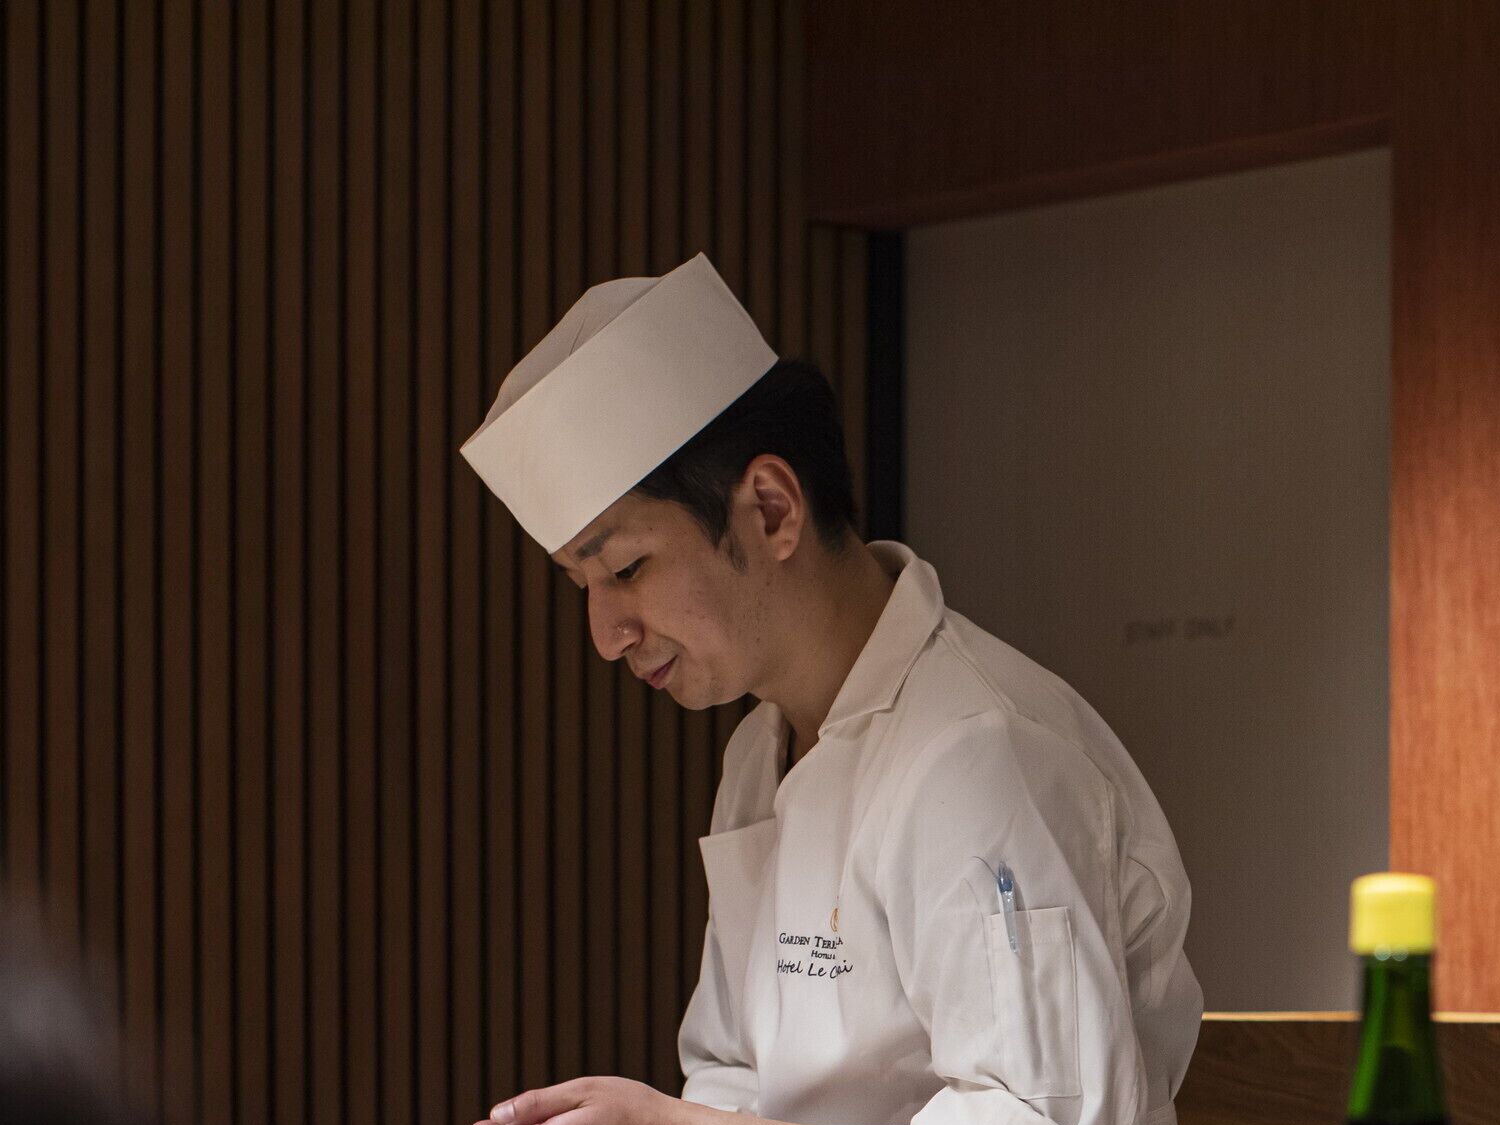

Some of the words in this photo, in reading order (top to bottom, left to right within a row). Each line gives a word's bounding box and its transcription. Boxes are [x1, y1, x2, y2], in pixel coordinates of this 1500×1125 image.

[779, 932, 810, 945] GARDEN
[777, 959, 803, 973] Hotel
[808, 963, 826, 977] Le
